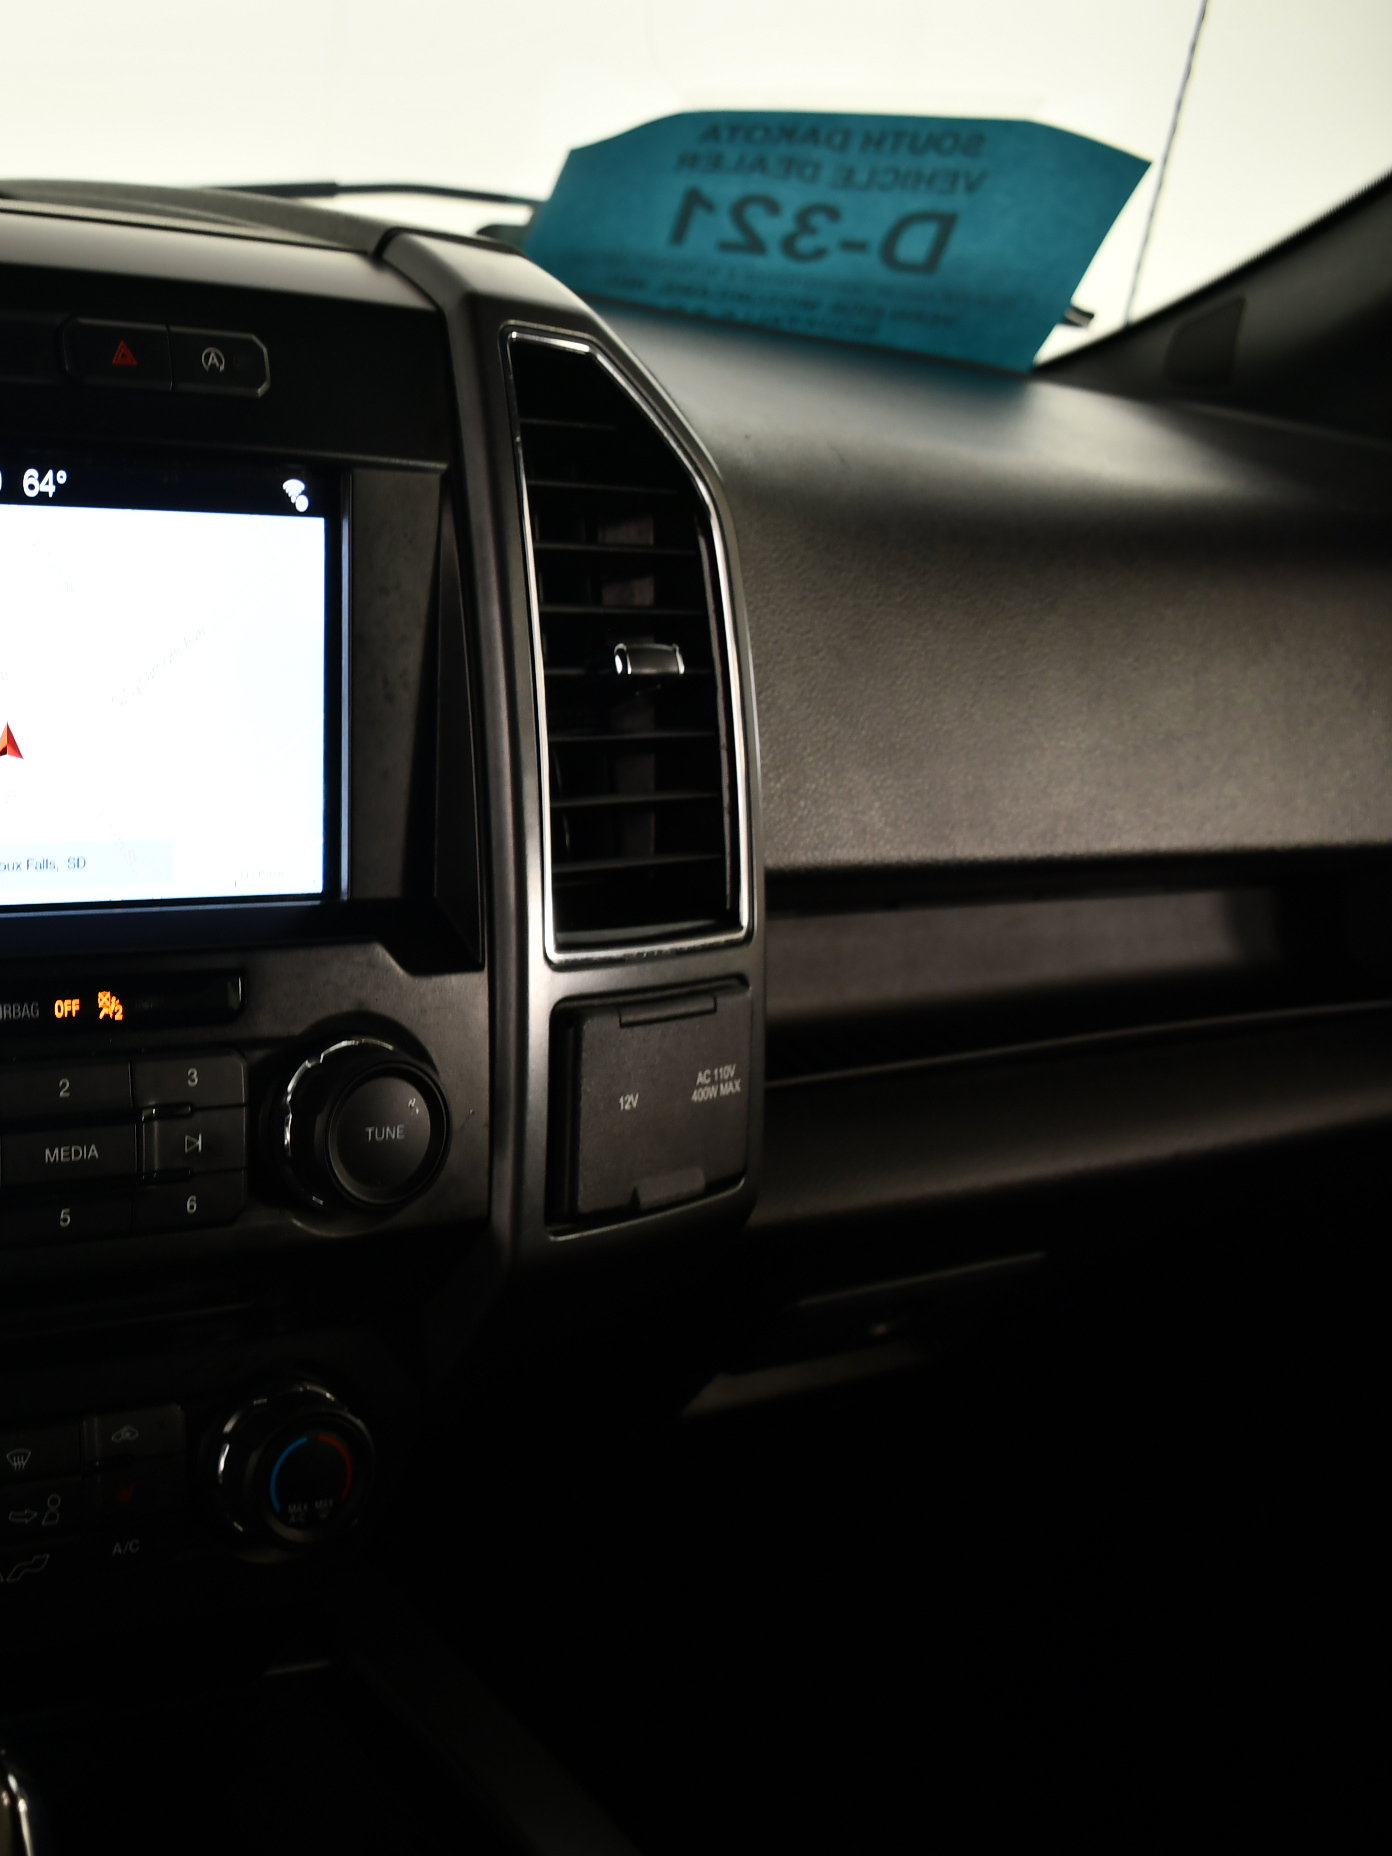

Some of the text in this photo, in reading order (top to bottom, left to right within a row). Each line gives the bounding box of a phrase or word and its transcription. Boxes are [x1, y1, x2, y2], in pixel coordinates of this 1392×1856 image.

[67, 856, 87, 871] SD
[53, 998, 81, 1020] OFF
[58, 1078, 71, 1098] 2
[186, 1067, 199, 1087] 3
[696, 1064, 737, 1085] AC 110V
[691, 1079, 741, 1102] 400W MAX
[618, 1093, 639, 1111] 12V
[365, 1124, 406, 1142] TUNE
[44, 1144, 99, 1164] MEDIA
[59, 1208, 71, 1228] 5
[186, 1195, 198, 1214] 6
[112, 1537, 140, 1557] A/C
